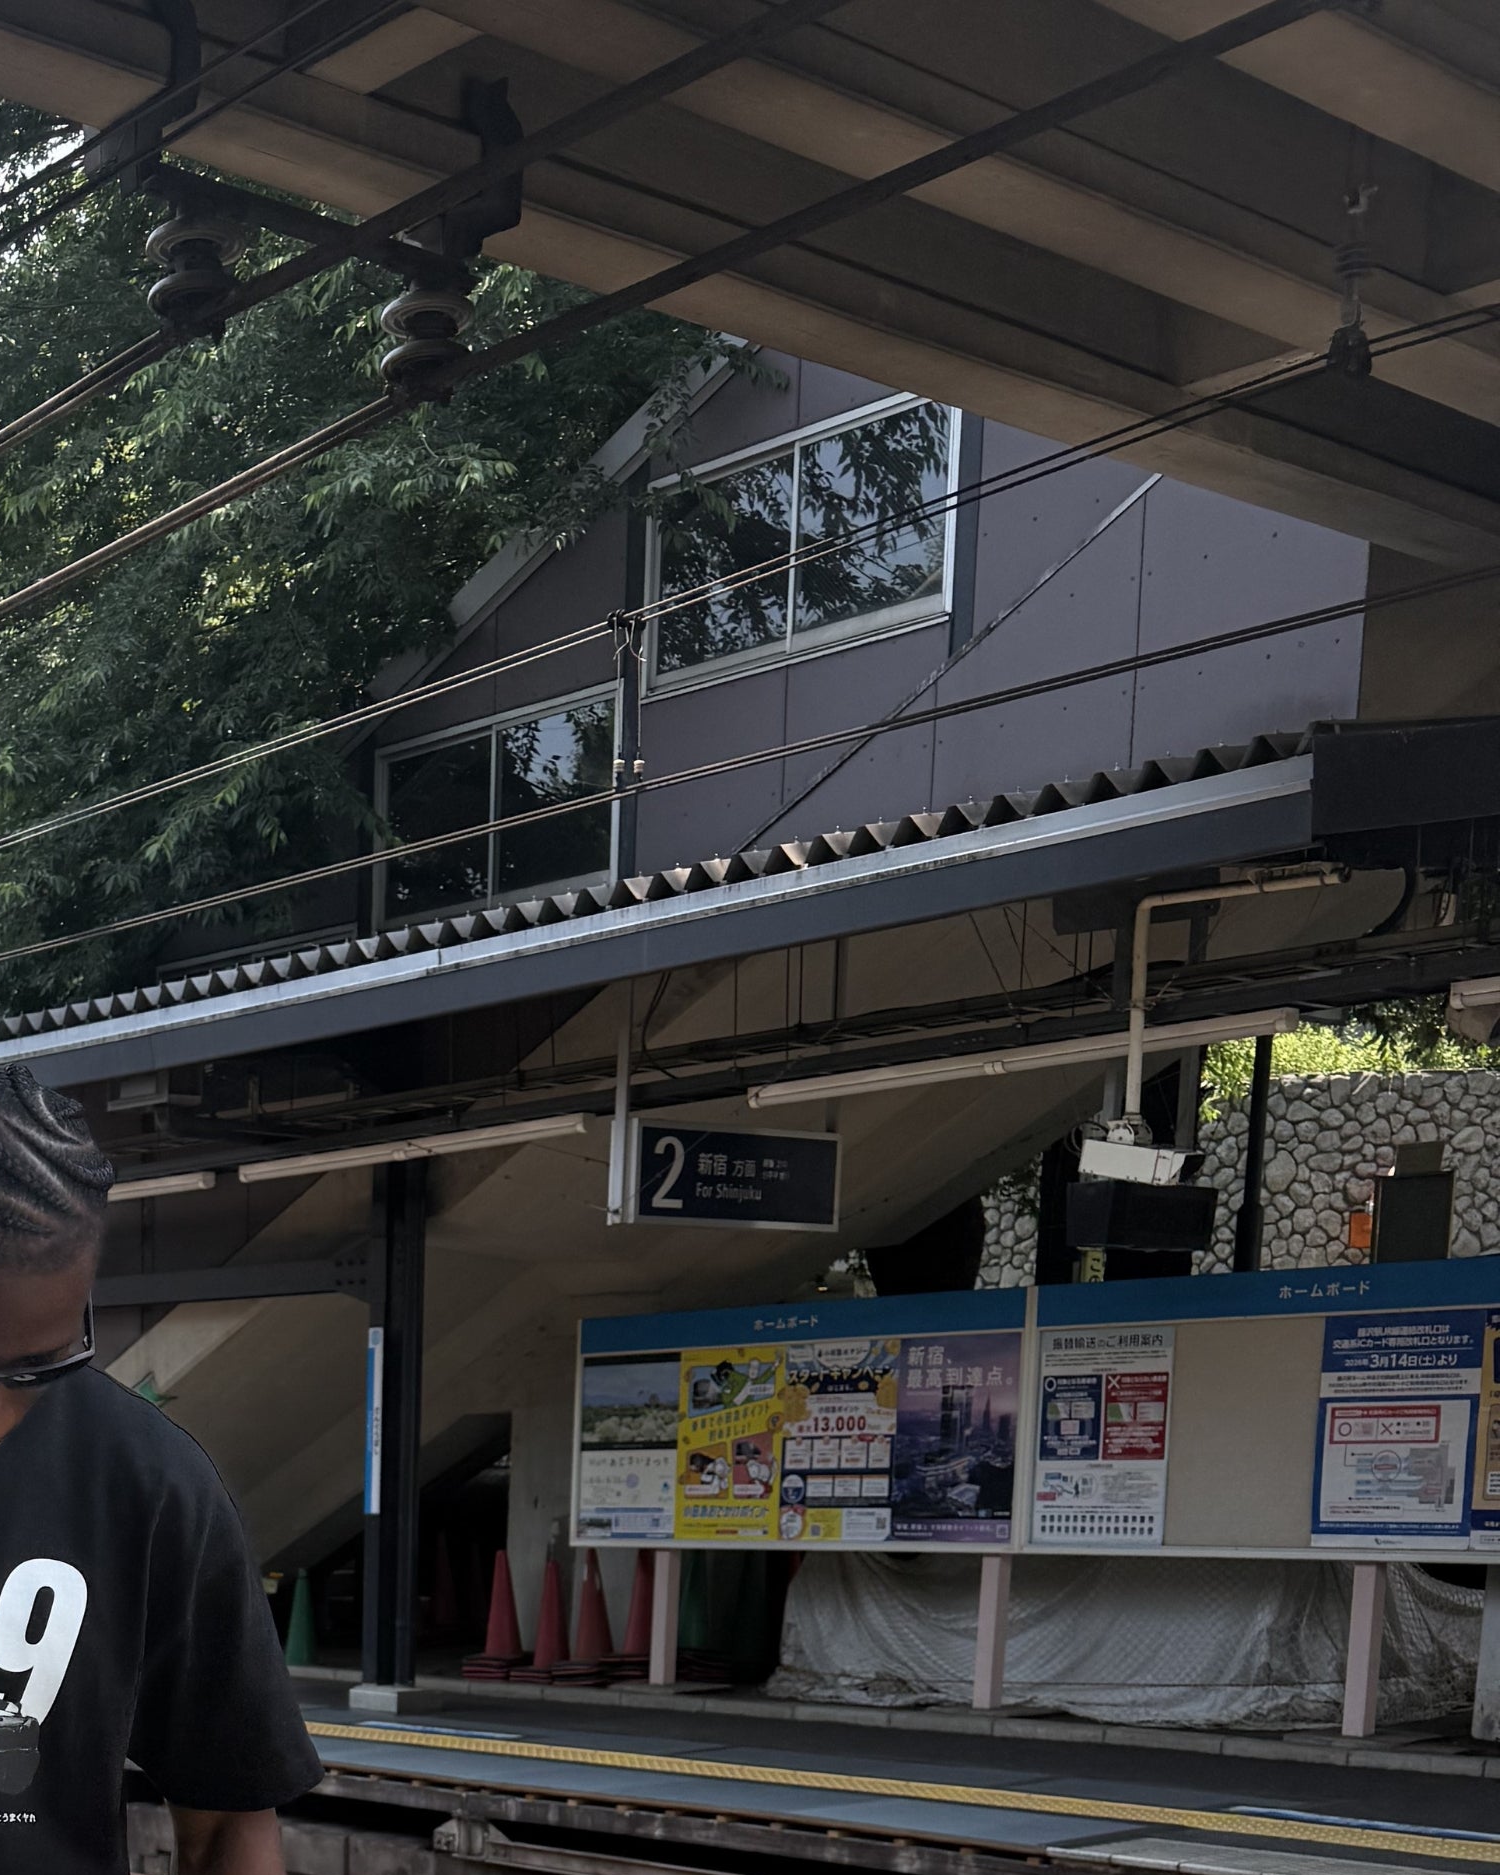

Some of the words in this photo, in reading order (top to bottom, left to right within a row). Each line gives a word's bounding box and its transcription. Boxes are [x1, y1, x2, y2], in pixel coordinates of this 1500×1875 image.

[651, 1135, 685, 1209] 2
[697, 1152, 728, 1176] 新宿
[695, 1182, 713, 1199] For
[716, 1183, 762, 1204] Shinjuku
[1279, 1279, 1371, 1299] ホームボード
[753, 1314, 819, 1332] ホームボード
[1052, 1333, 1163, 1350] 振替輸送のご利用案内
[908, 1346, 952, 1366] 新宿、
[906, 1365, 1013, 1389] 最高到達点。
[813, 1416, 866, 1432] 13,000
